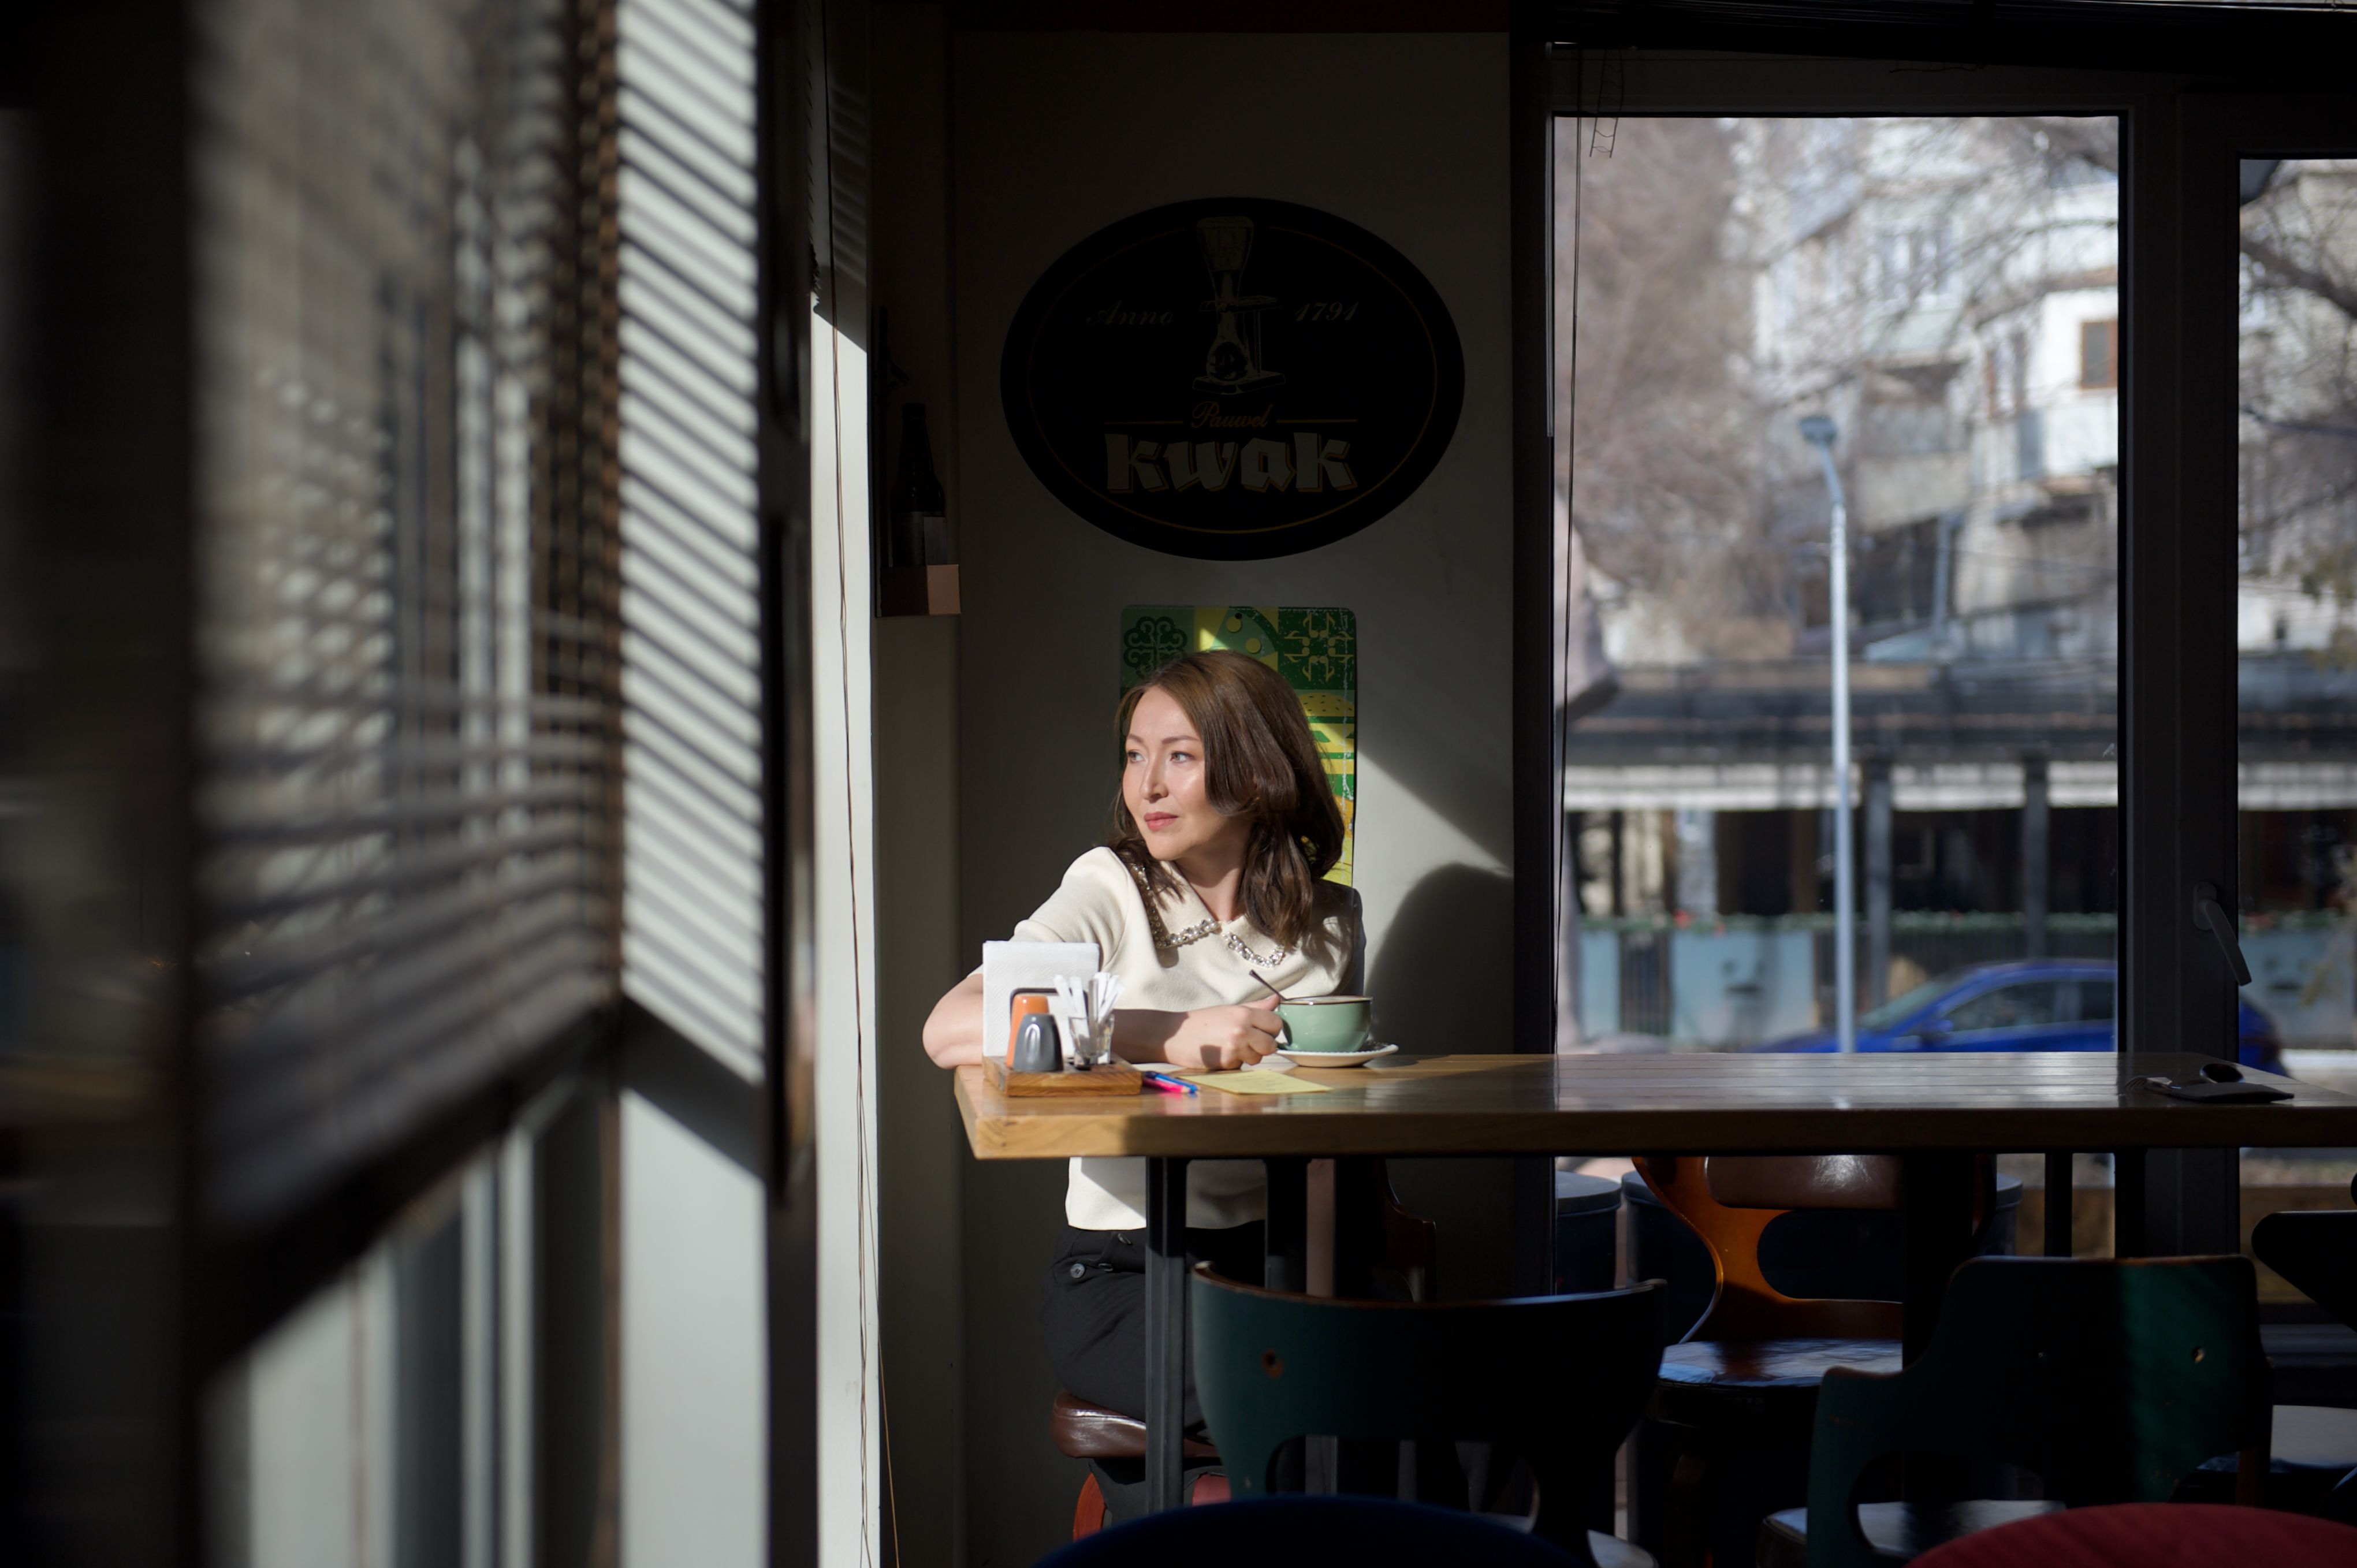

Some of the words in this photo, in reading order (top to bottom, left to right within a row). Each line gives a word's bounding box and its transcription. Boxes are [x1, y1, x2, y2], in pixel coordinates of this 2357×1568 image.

[1086, 299, 1175, 326] Anno
[1293, 300, 1360, 322] 1791
[1191, 400, 1274, 429] Pauwel
